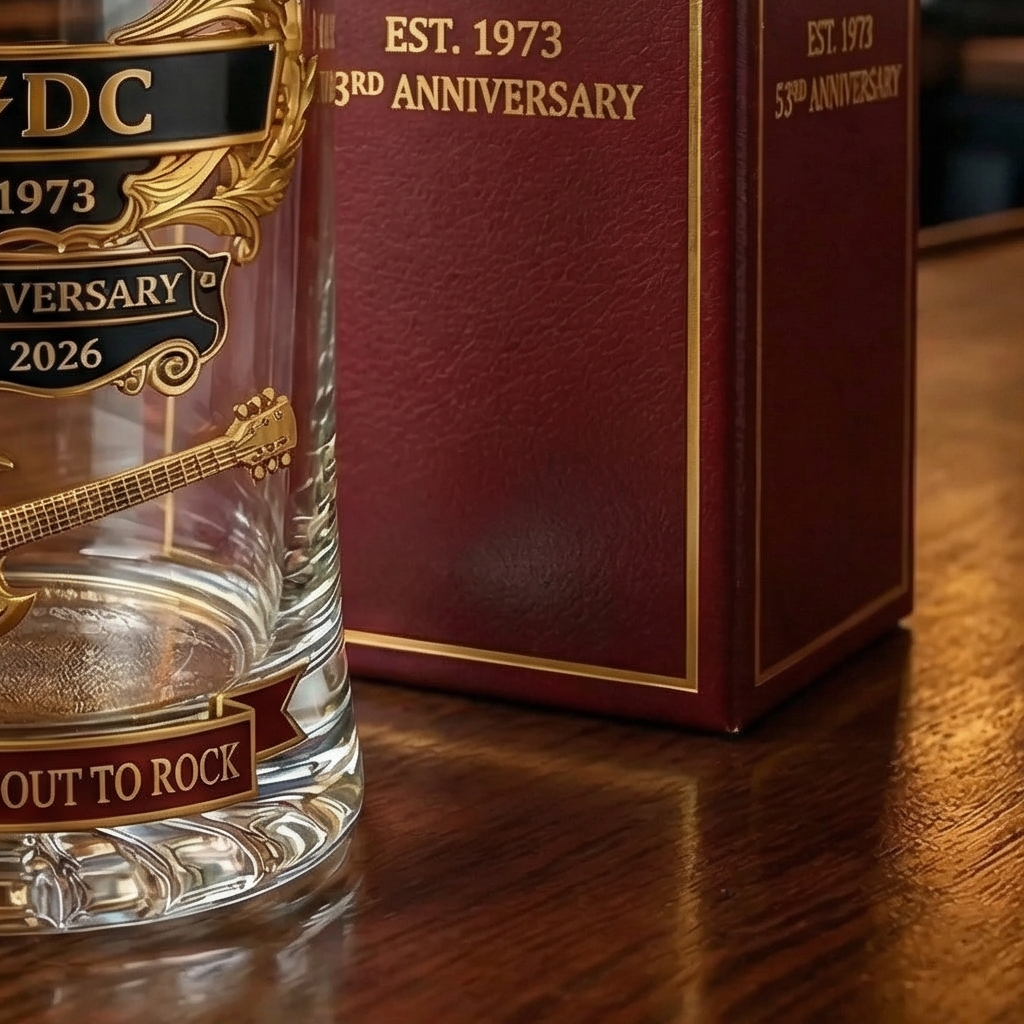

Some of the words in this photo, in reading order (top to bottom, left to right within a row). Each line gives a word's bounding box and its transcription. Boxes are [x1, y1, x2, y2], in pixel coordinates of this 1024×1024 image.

[385, 16, 460, 55] EST.
[473, 18, 563, 60] 1973
[841, 14, 874, 53] 1973
[319, 70, 385, 108] 3RD
[391, 73, 644, 122] ANNIVERSARY
[775, 78, 807, 119] 53RD
[808, 63, 903, 114] ANNIVERSARY
[10, 338, 103, 373] 2026
[92, 761, 144, 803] TO
[152, 741, 242, 797] ROCK
